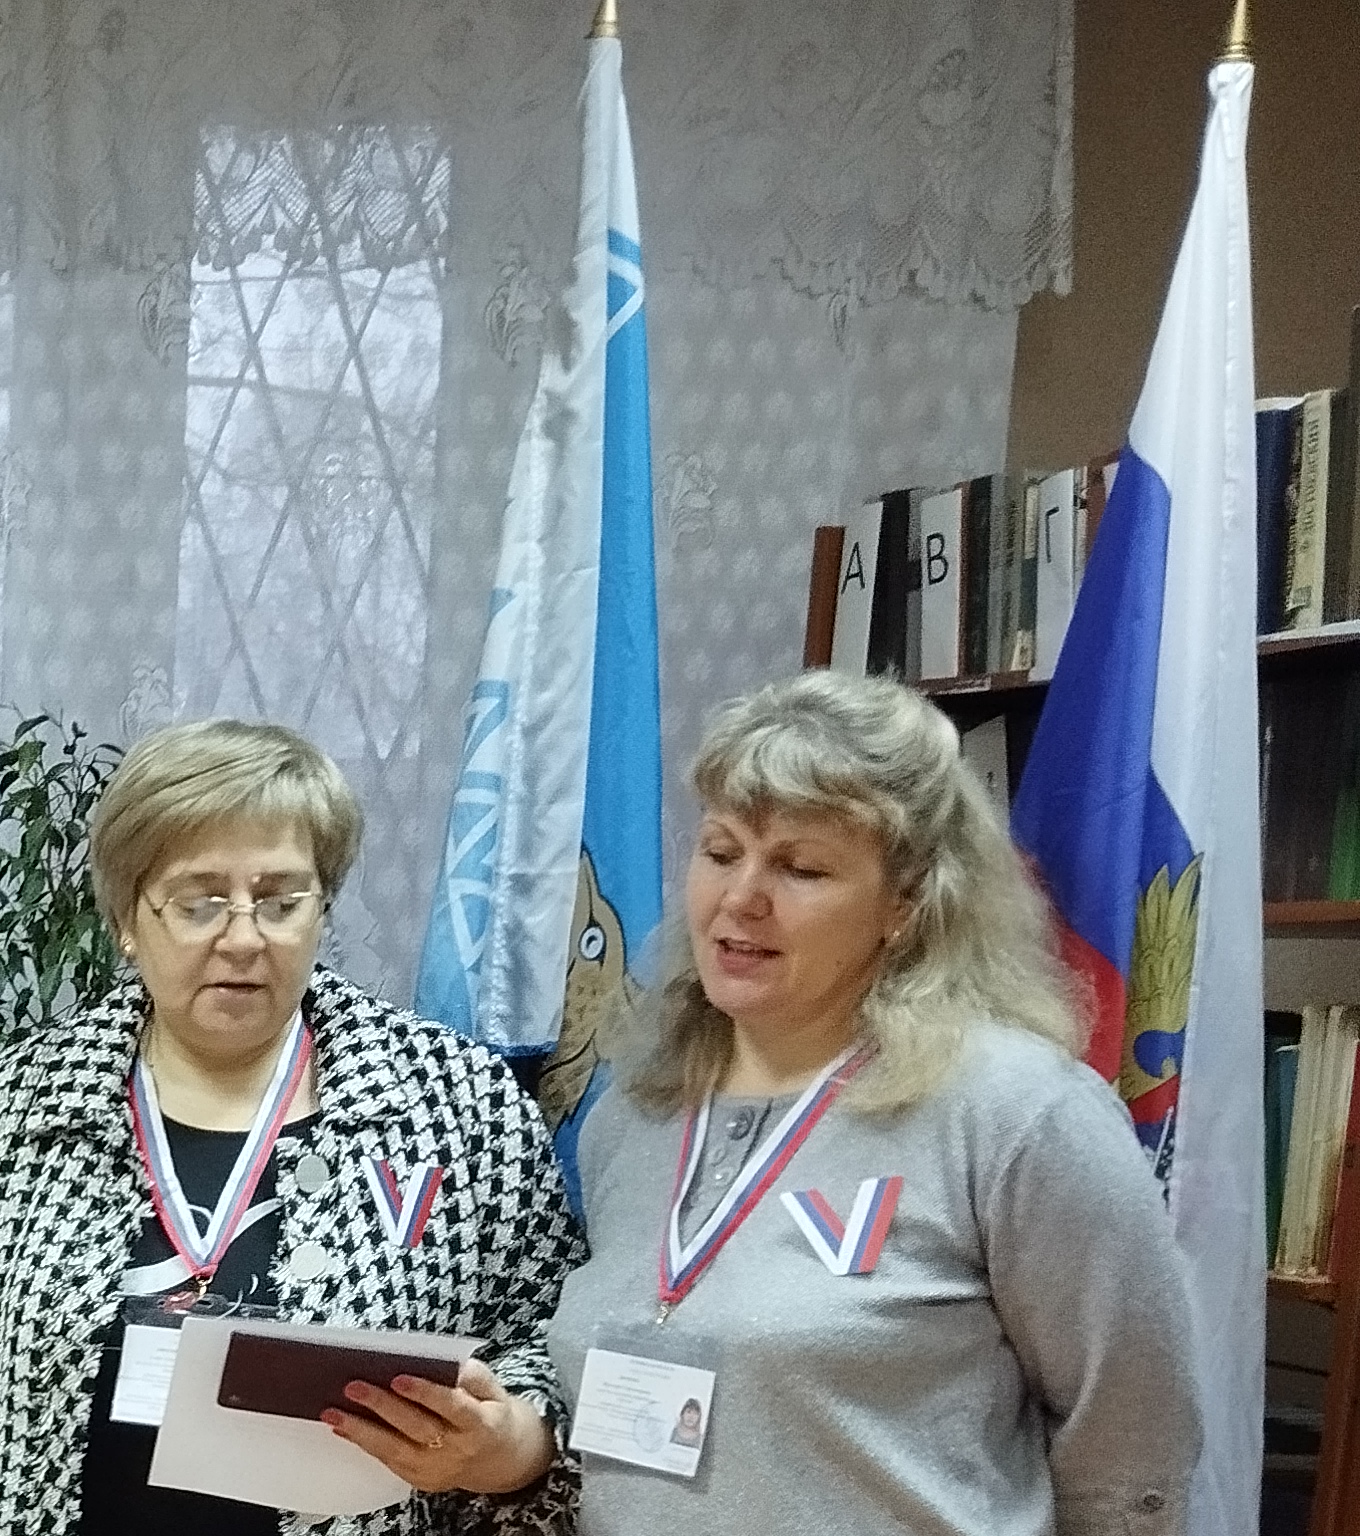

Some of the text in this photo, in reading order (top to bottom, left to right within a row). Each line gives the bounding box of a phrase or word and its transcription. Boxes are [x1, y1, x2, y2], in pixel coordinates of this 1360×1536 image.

[925, 532, 950, 586] В
[1043, 505, 1060, 564] Г
[841, 540, 866, 596] А
